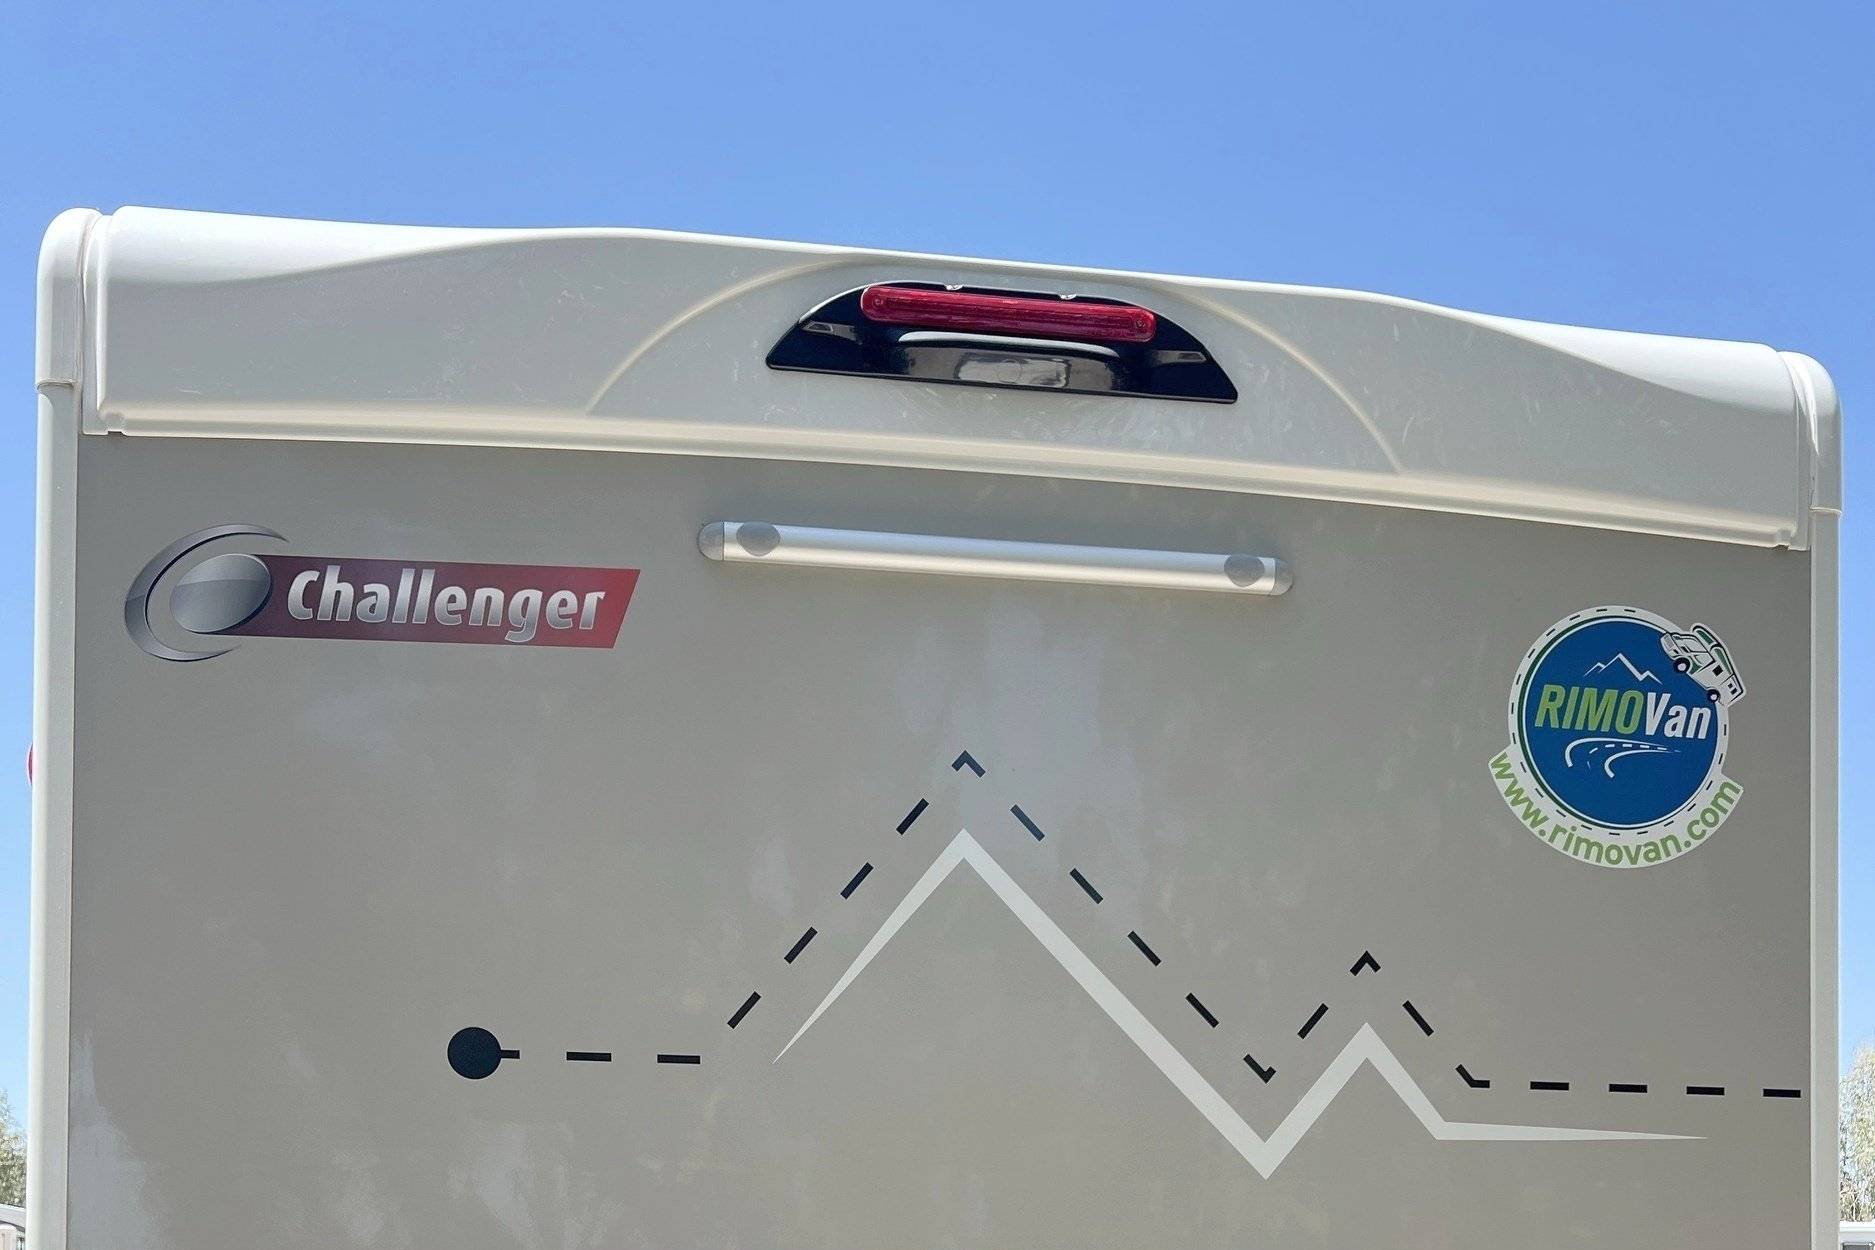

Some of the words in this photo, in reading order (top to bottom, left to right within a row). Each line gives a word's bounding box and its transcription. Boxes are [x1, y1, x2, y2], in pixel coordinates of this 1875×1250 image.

[287, 564, 606, 643] Challenger
[1534, 683, 1712, 740] RIMOVan
[1489, 751, 1741, 866] www.rimovan.com
